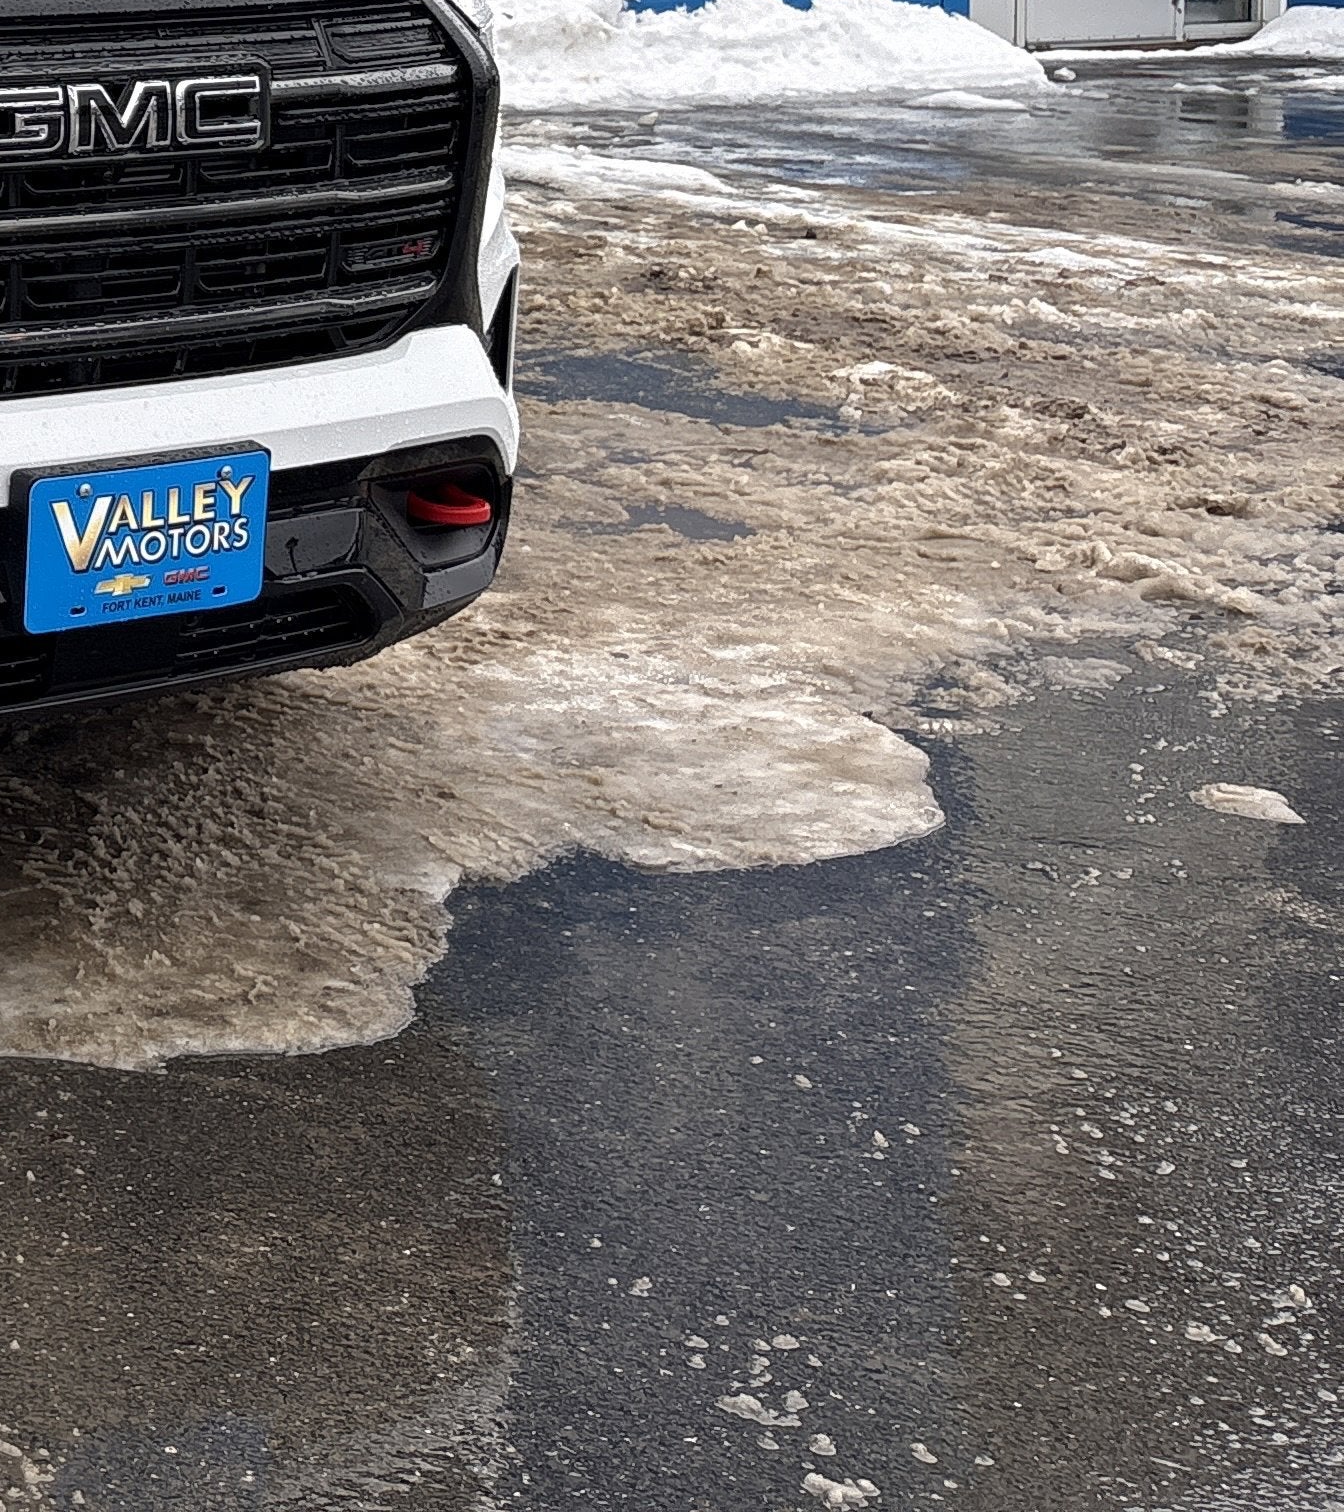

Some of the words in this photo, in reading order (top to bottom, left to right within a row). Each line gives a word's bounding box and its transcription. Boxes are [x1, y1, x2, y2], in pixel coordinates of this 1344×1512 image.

[51, 475, 256, 573] VALLEY
[94, 517, 248, 570] MOTORS
[163, 566, 210, 586] GMC
[102, 598, 132, 614] FORT
[134, 595, 165, 610] KENT,
[166, 589, 202, 605] MAINE
